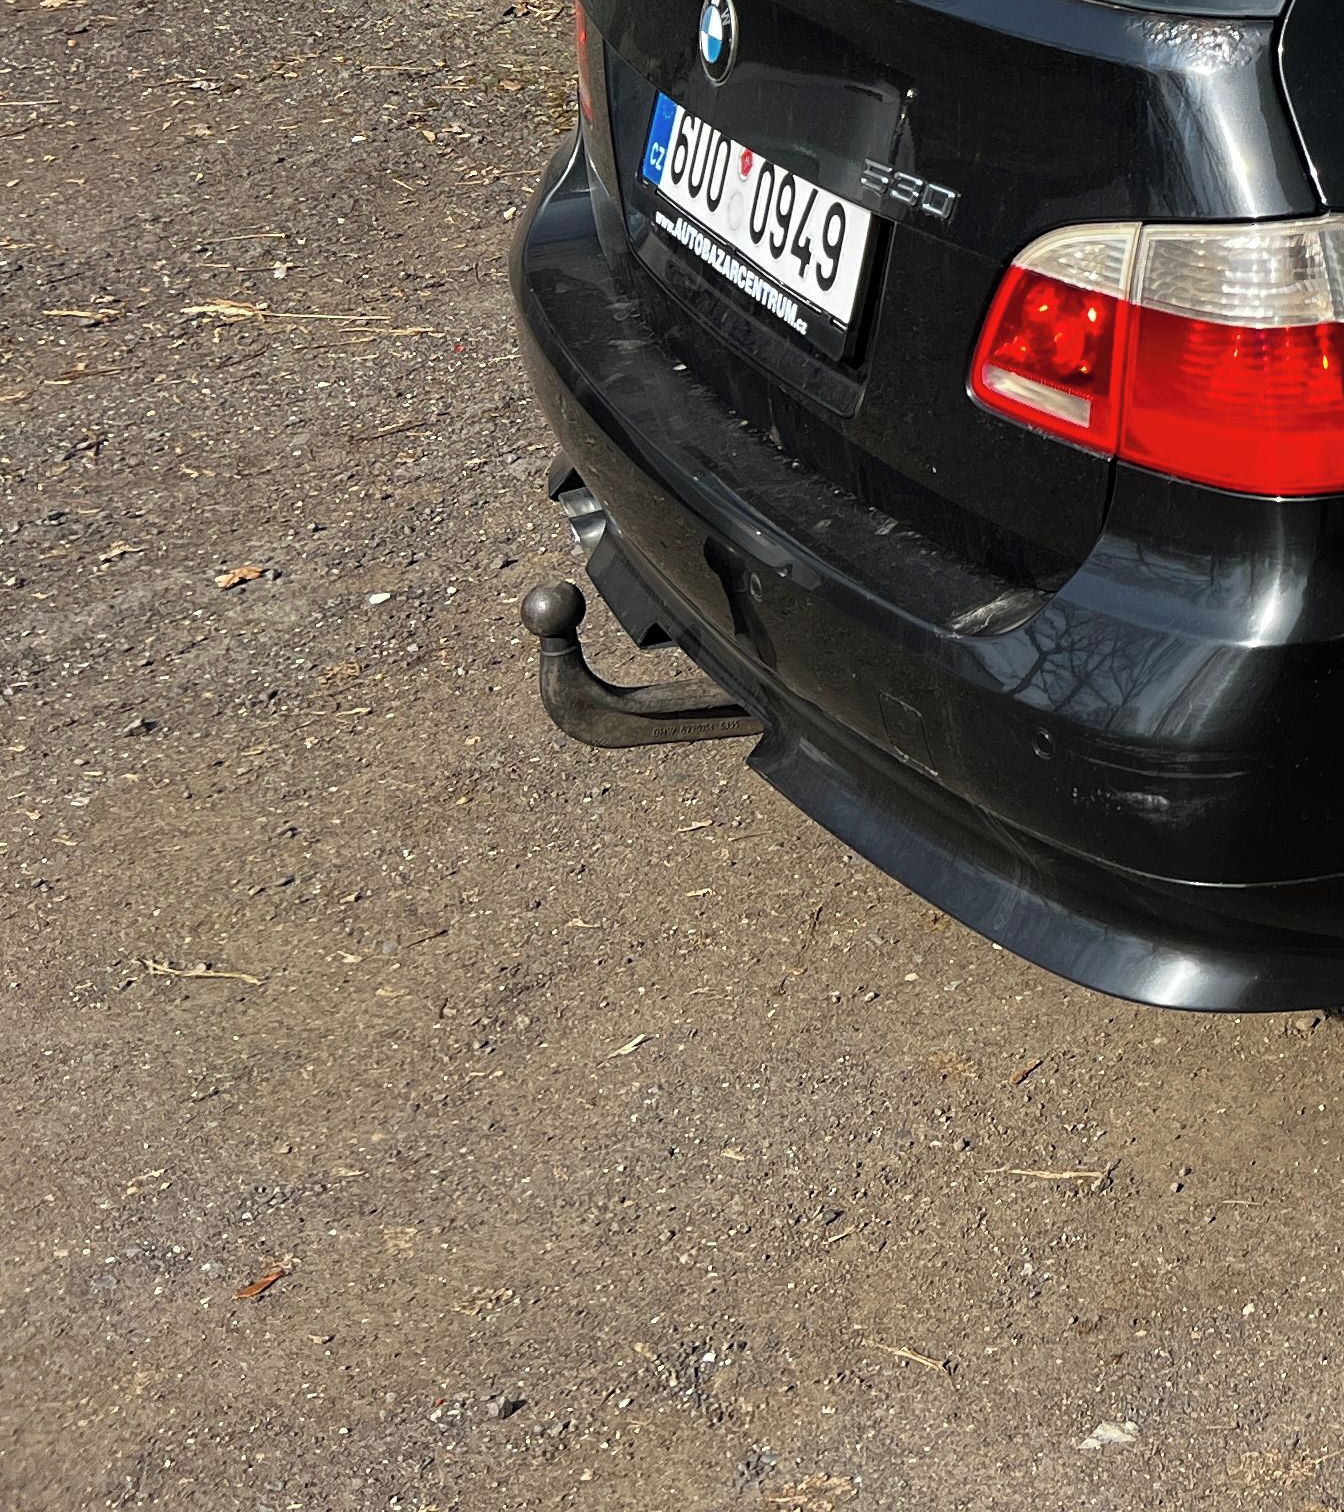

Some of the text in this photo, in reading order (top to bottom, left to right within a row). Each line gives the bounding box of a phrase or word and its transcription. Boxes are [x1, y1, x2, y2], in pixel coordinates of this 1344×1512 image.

[650, 141, 666, 172] CZ
[655, 210, 809, 336] www.AUTOBAZARCENTRUM.cz
[749, 160, 847, 292] 0949
